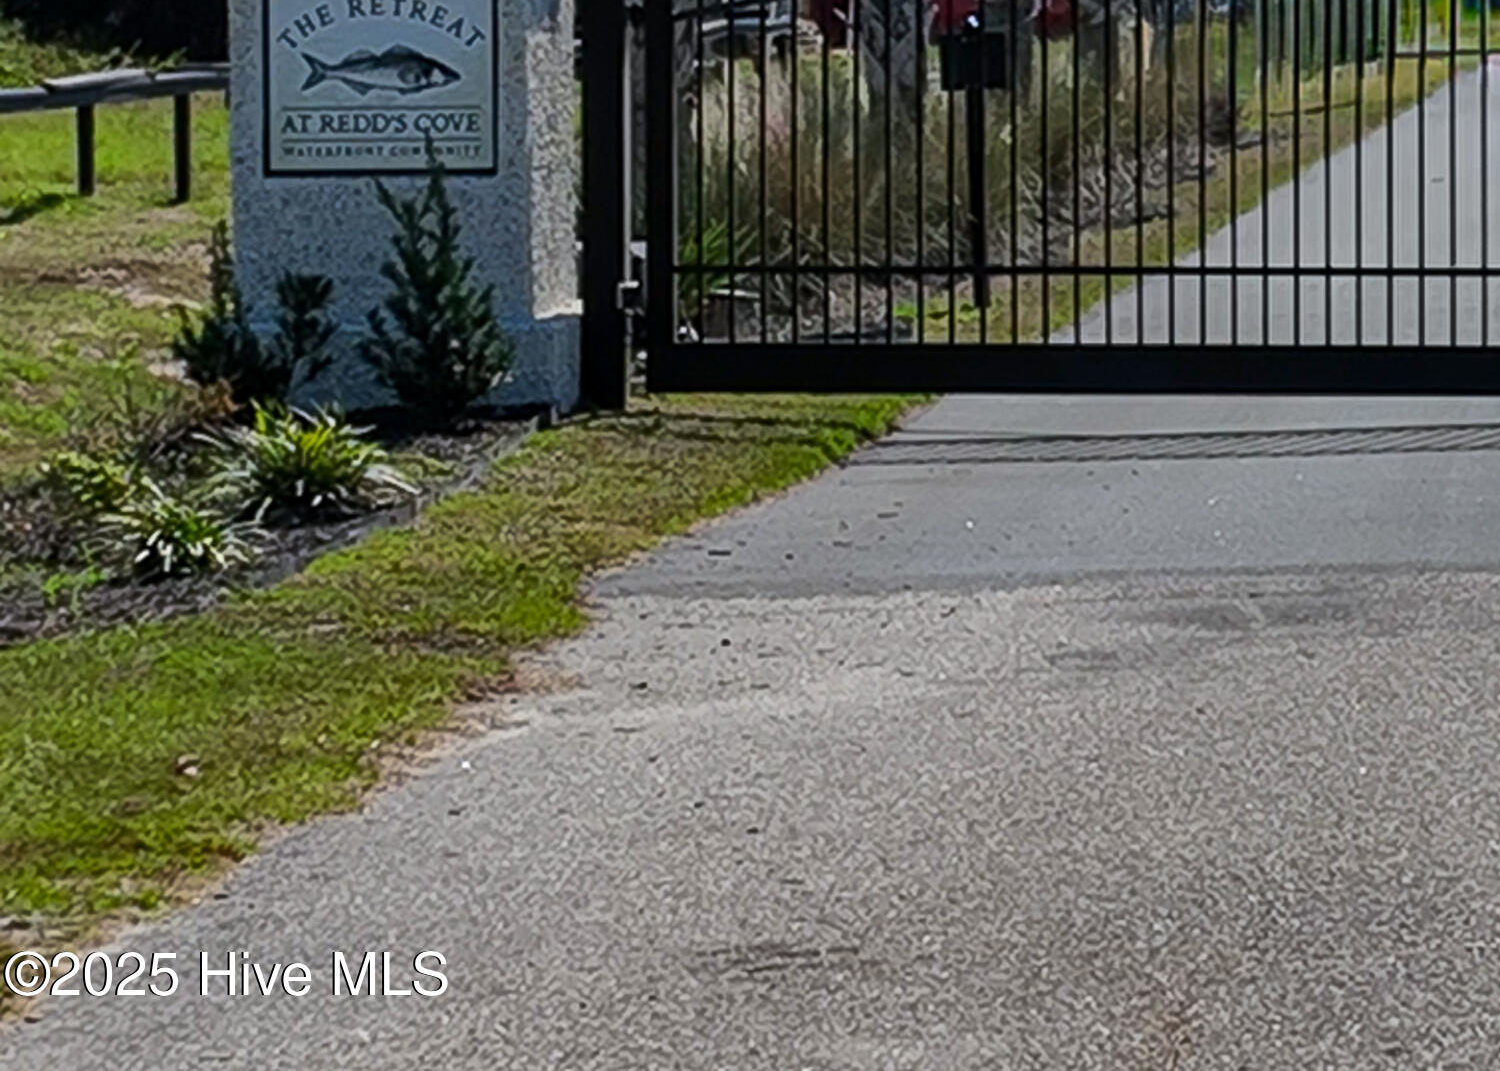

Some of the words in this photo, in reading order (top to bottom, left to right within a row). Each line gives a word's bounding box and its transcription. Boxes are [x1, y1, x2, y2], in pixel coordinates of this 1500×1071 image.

[276, 4, 335, 49] THE
[280, 113, 312, 134] AT
[319, 113, 408, 134] REDD'S
[413, 113, 481, 134] COVE
